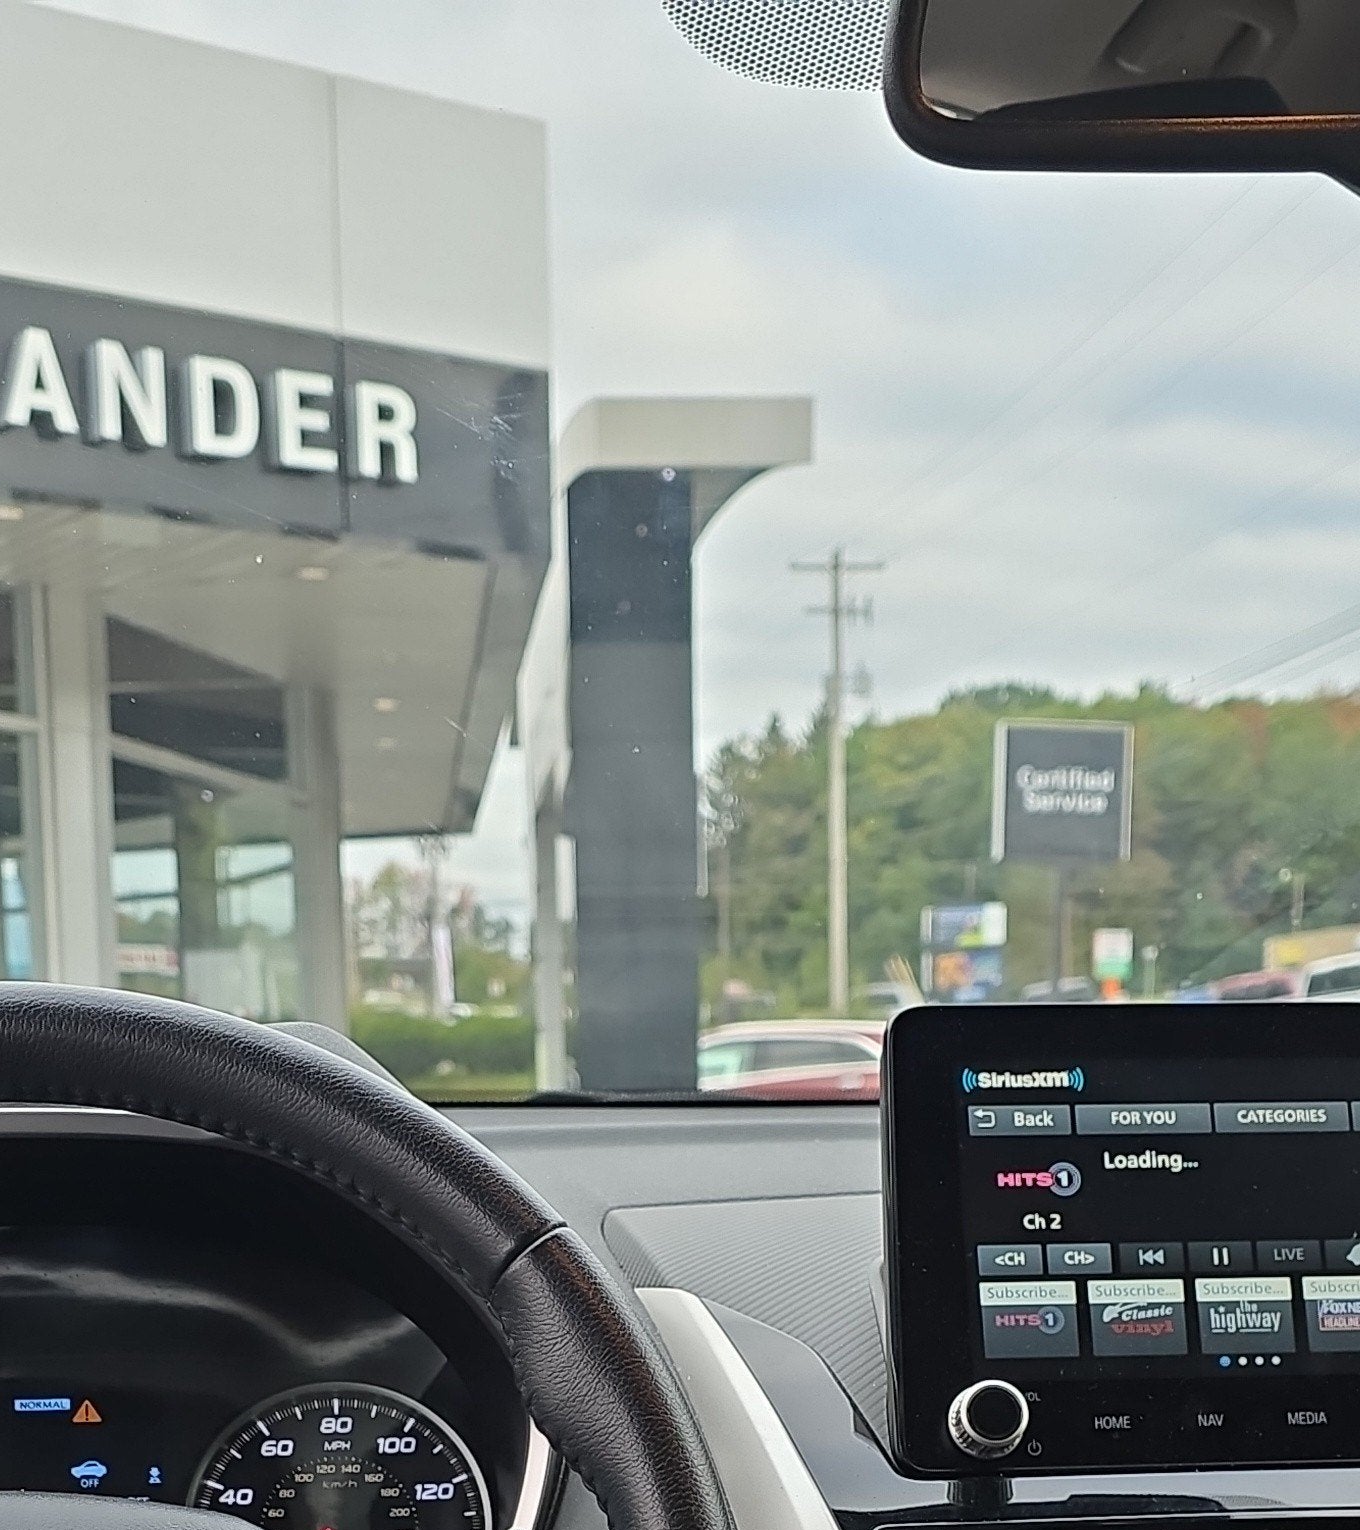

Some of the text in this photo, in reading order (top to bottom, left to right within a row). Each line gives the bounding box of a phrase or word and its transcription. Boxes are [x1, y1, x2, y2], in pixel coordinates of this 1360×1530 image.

[1016, 764, 1115, 792] Certified
[1022, 790, 1109, 813] Service
[1013, 1109, 1055, 1127] Back
[1110, 1110, 1177, 1125] FOR YOU
[1237, 1109, 1327, 1124] CATEGORIES
[1103, 1149, 1199, 1173] Loading...
[1023, 1213, 1062, 1230] Ch 2
[1273, 1247, 1305, 1261] LIVE
[987, 1287, 1068, 1299] Subscribe...
[1095, 1285, 1176, 1297] Subscribe...
[1203, 1283, 1284, 1296] Subscribe...
[1121, 1305, 1173, 1321] Classic
[1240, 1300, 1258, 1312] the
[1210, 1305, 1281, 1330] highway
[1025, 1391, 1041, 1401] OL
[19, 1401, 68, 1410] NORMAL
[319, 1416, 353, 1434] 80
[1094, 1415, 1131, 1430] HOME
[1197, 1413, 1225, 1427] NAV
[1287, 1411, 1328, 1425] MEDIA
[260, 1439, 294, 1457] 60
[323, 1440, 351, 1451] MPH
[377, 1437, 416, 1454] 100
[316, 1464, 336, 1474] 120
[340, 1464, 361, 1474] 140
[80, 1479, 100, 1488] OFF
[294, 1473, 314, 1482] 100
[218, 1488, 254, 1505] 40
[279, 1488, 295, 1498] 80
[414, 1483, 454, 1501] 120
[268, 1508, 284, 1518] 60
[389, 1507, 410, 1517] 200
